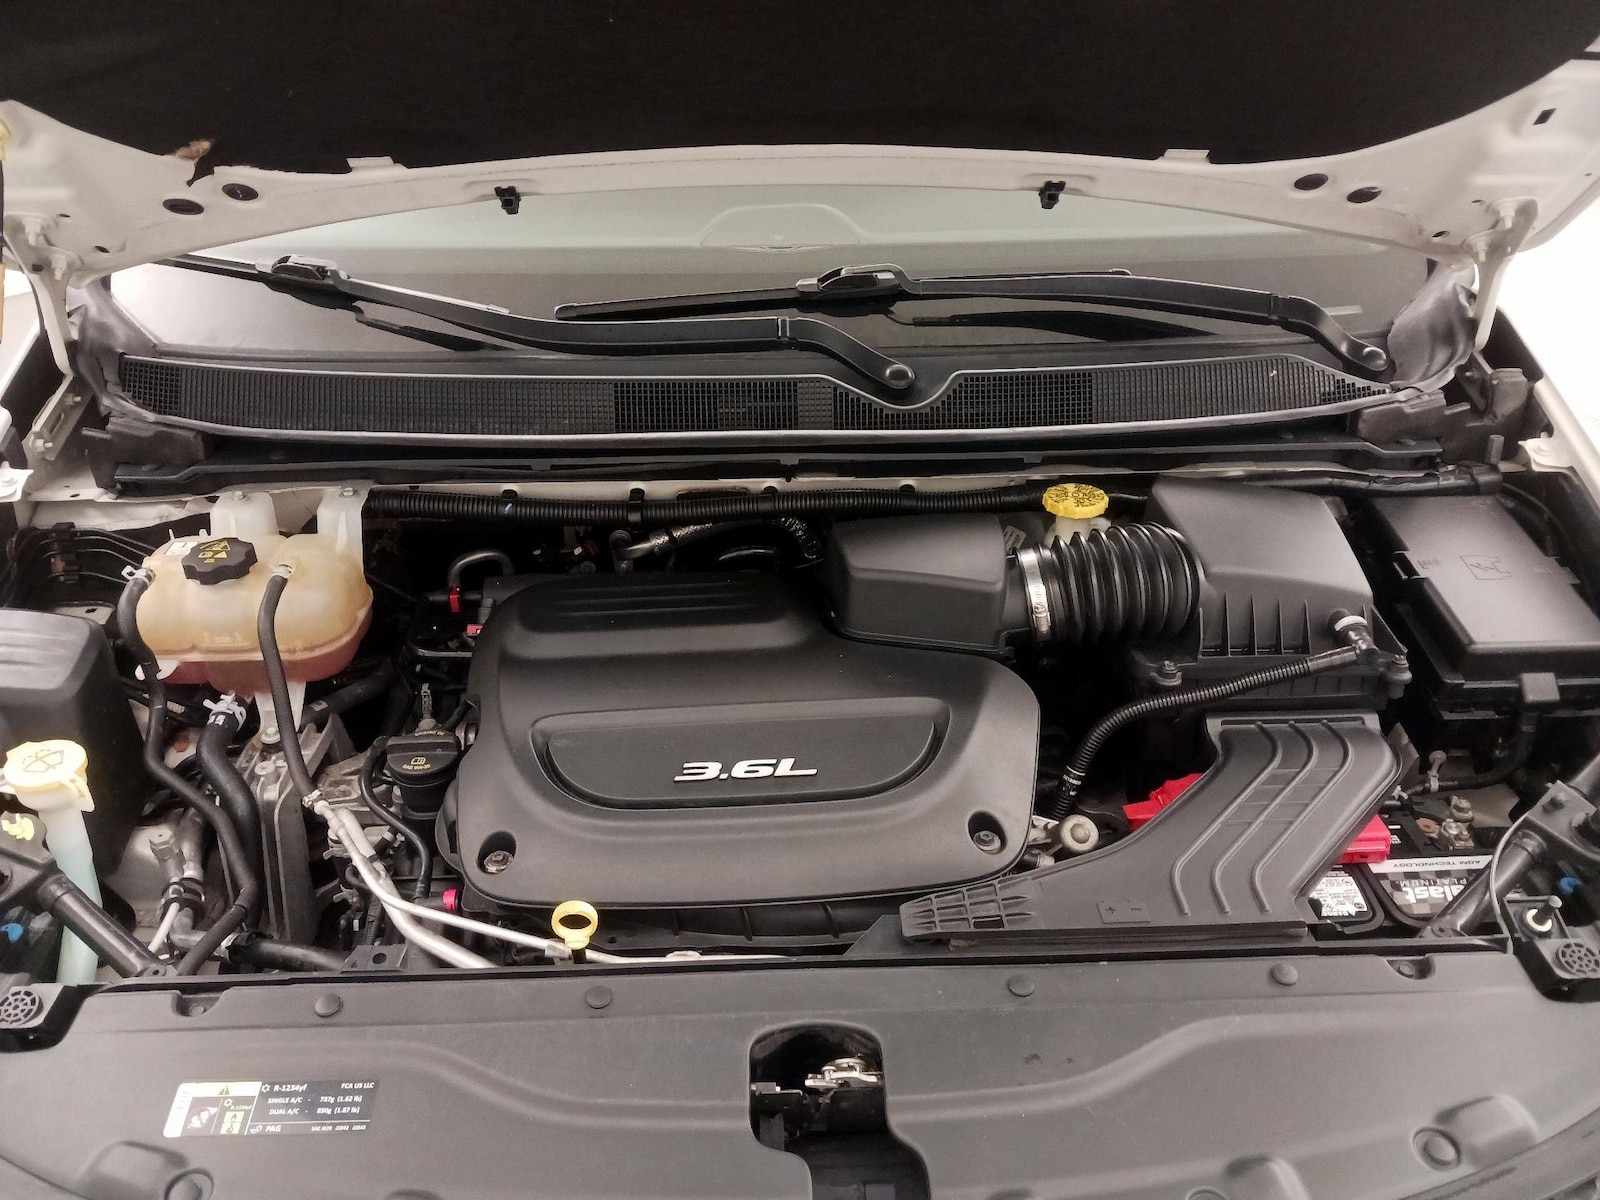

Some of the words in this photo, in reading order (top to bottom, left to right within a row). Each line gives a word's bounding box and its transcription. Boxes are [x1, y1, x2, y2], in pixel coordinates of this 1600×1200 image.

[673, 757, 818, 782] 3.6L
[1392, 860, 1457, 868] TECHNOLOGY
[273, 1083, 308, 1092] R-1234yf
[265, 1125, 282, 1133] PAG
